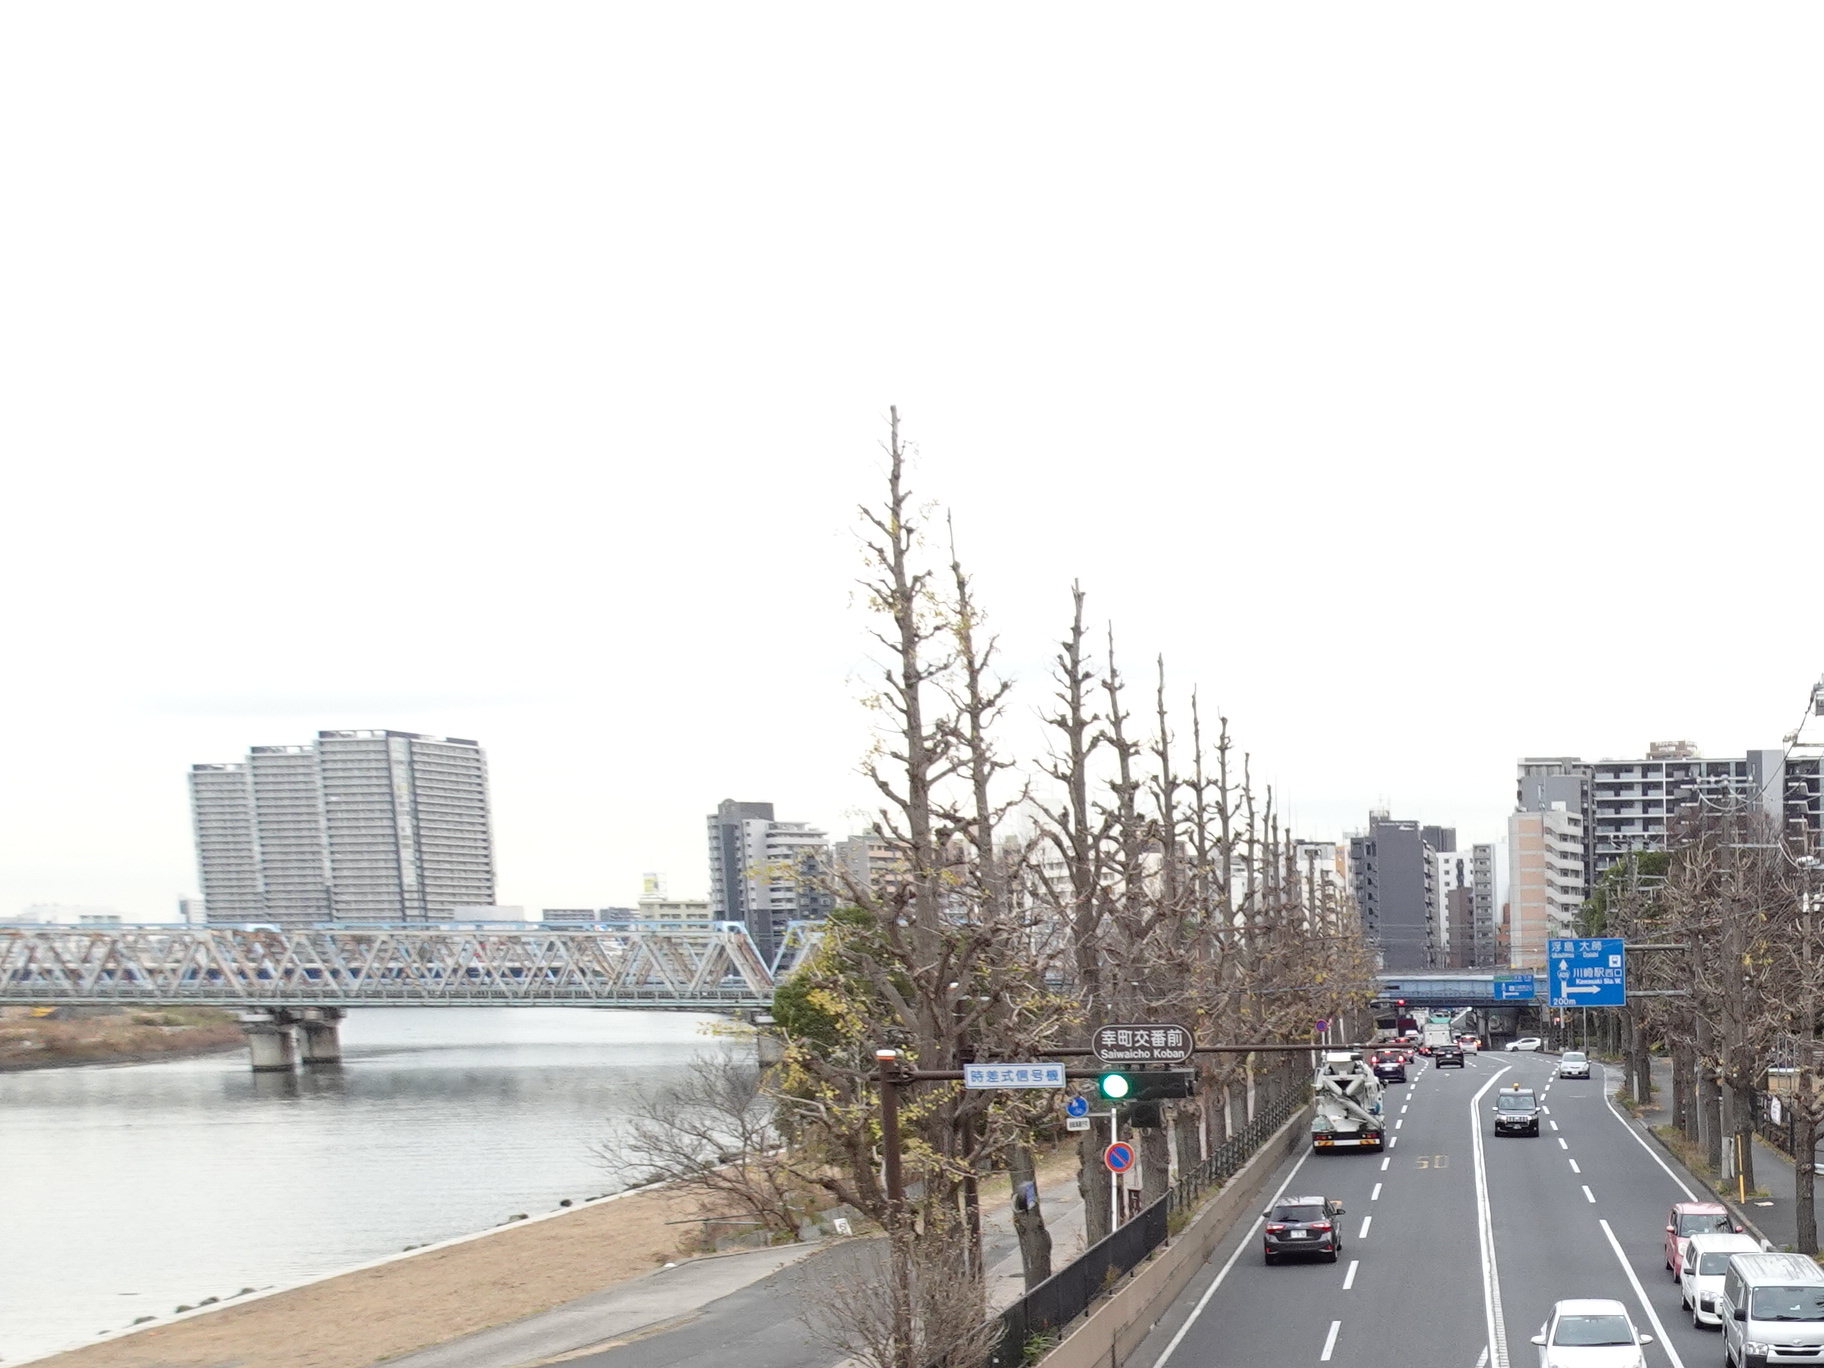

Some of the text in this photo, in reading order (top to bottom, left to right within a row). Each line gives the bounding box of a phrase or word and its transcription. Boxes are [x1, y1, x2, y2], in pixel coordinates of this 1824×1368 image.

[1101, 1029, 1183, 1047] 幸町交番前
[1101, 1048, 1185, 1059] Saiwaicho Koban
[970, 1069, 1060, 1083] 時差式信号機
